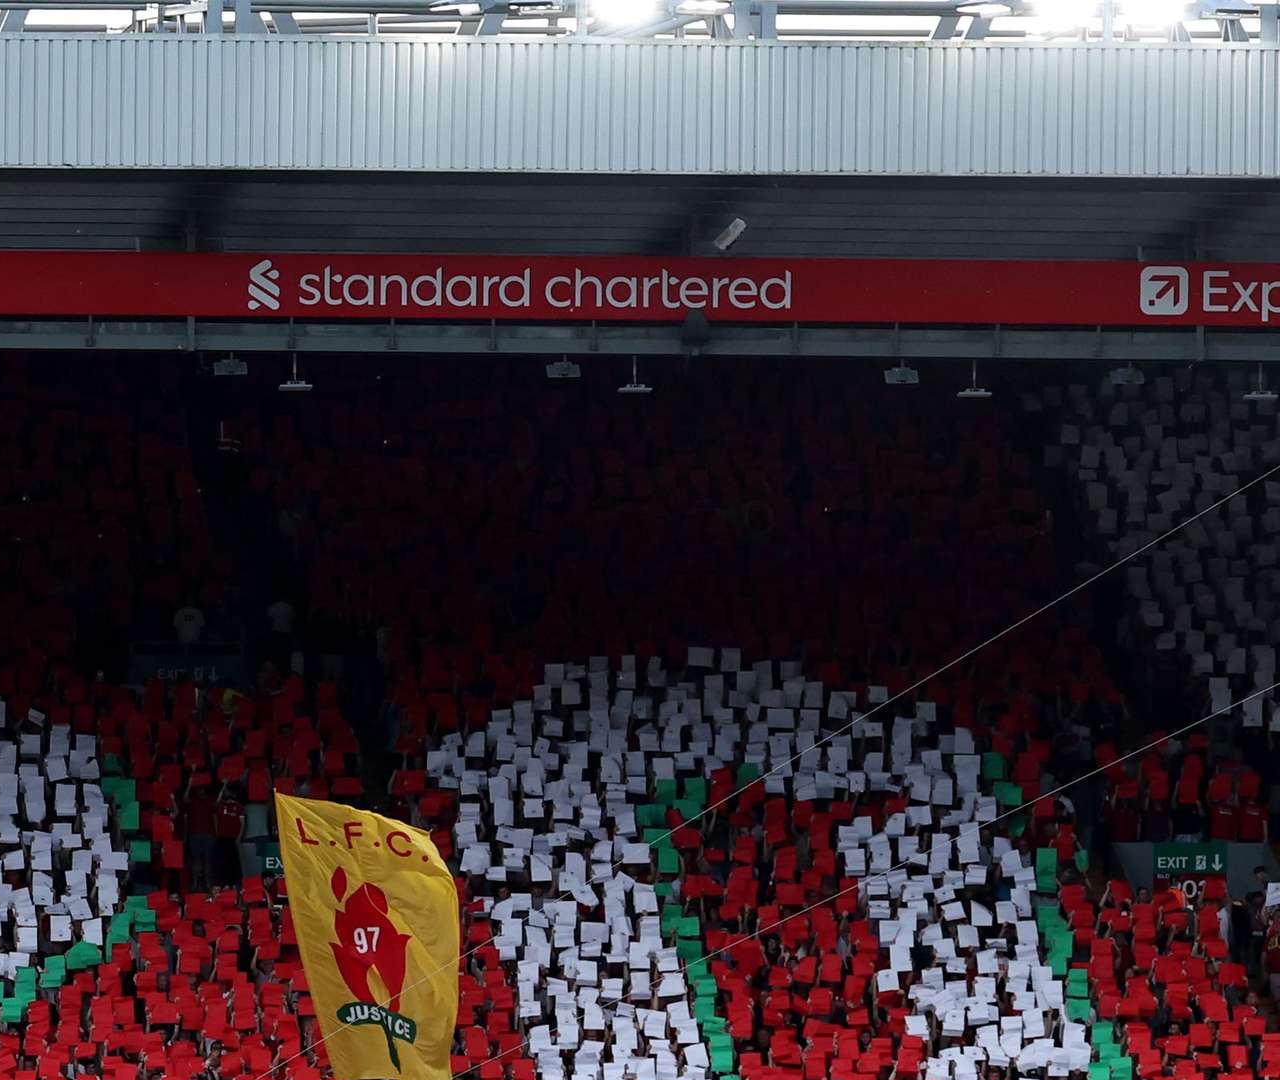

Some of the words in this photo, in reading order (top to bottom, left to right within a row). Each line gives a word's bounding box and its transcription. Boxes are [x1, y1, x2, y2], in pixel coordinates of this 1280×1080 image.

[297, 266, 531, 309] standard
[545, 268, 793, 311] chartered
[1204, 270, 1280, 317] Exp
[265, 857, 285, 869] EX
[1157, 856, 1189, 869] EXIT
[353, 927, 381, 954] 97
[345, 1006, 412, 1038] JUSTICE
